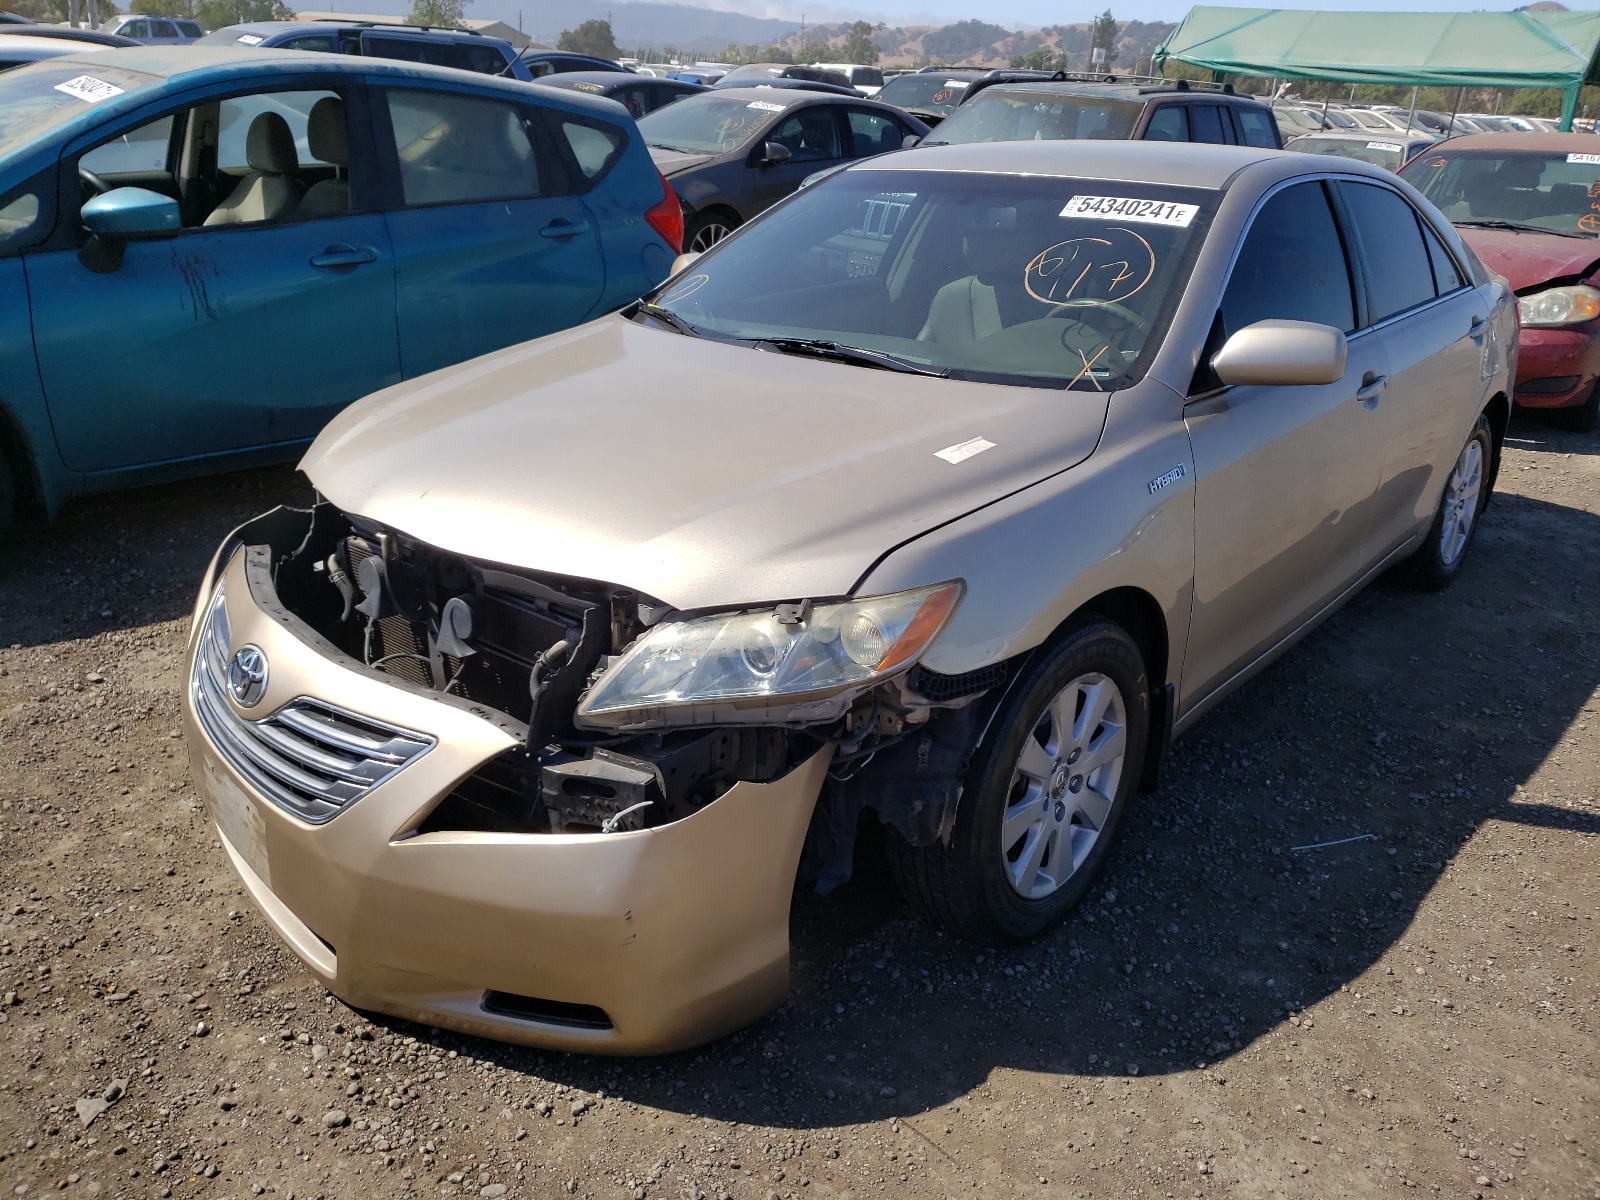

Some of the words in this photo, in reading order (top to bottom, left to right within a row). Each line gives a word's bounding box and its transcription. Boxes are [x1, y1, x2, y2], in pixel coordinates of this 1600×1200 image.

[1076, 197, 1178, 220] 54340241
[1175, 210, 1186, 219] F
[1148, 467, 1182, 494] HYBRID
